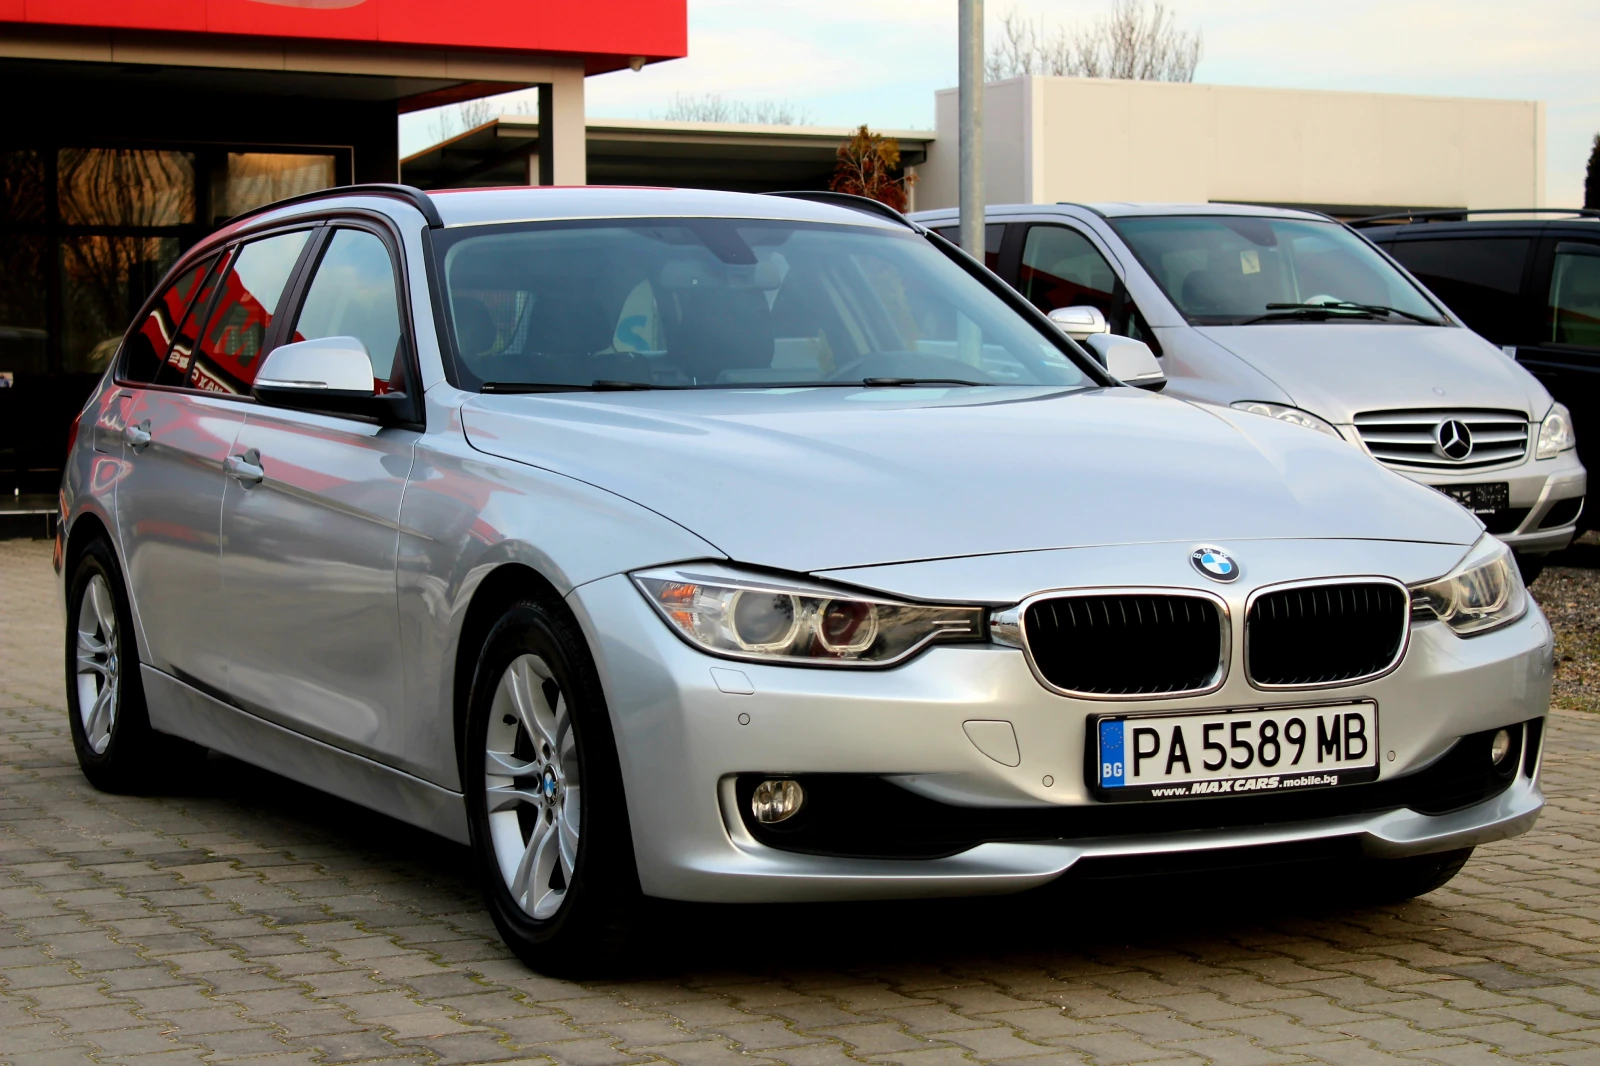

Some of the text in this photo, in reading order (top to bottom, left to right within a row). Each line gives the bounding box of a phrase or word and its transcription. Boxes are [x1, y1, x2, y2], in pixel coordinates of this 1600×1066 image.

[1193, 548, 1229, 559] BMW
[1132, 712, 1368, 777] PA 5589 MB
[1103, 762, 1122, 778] BG
